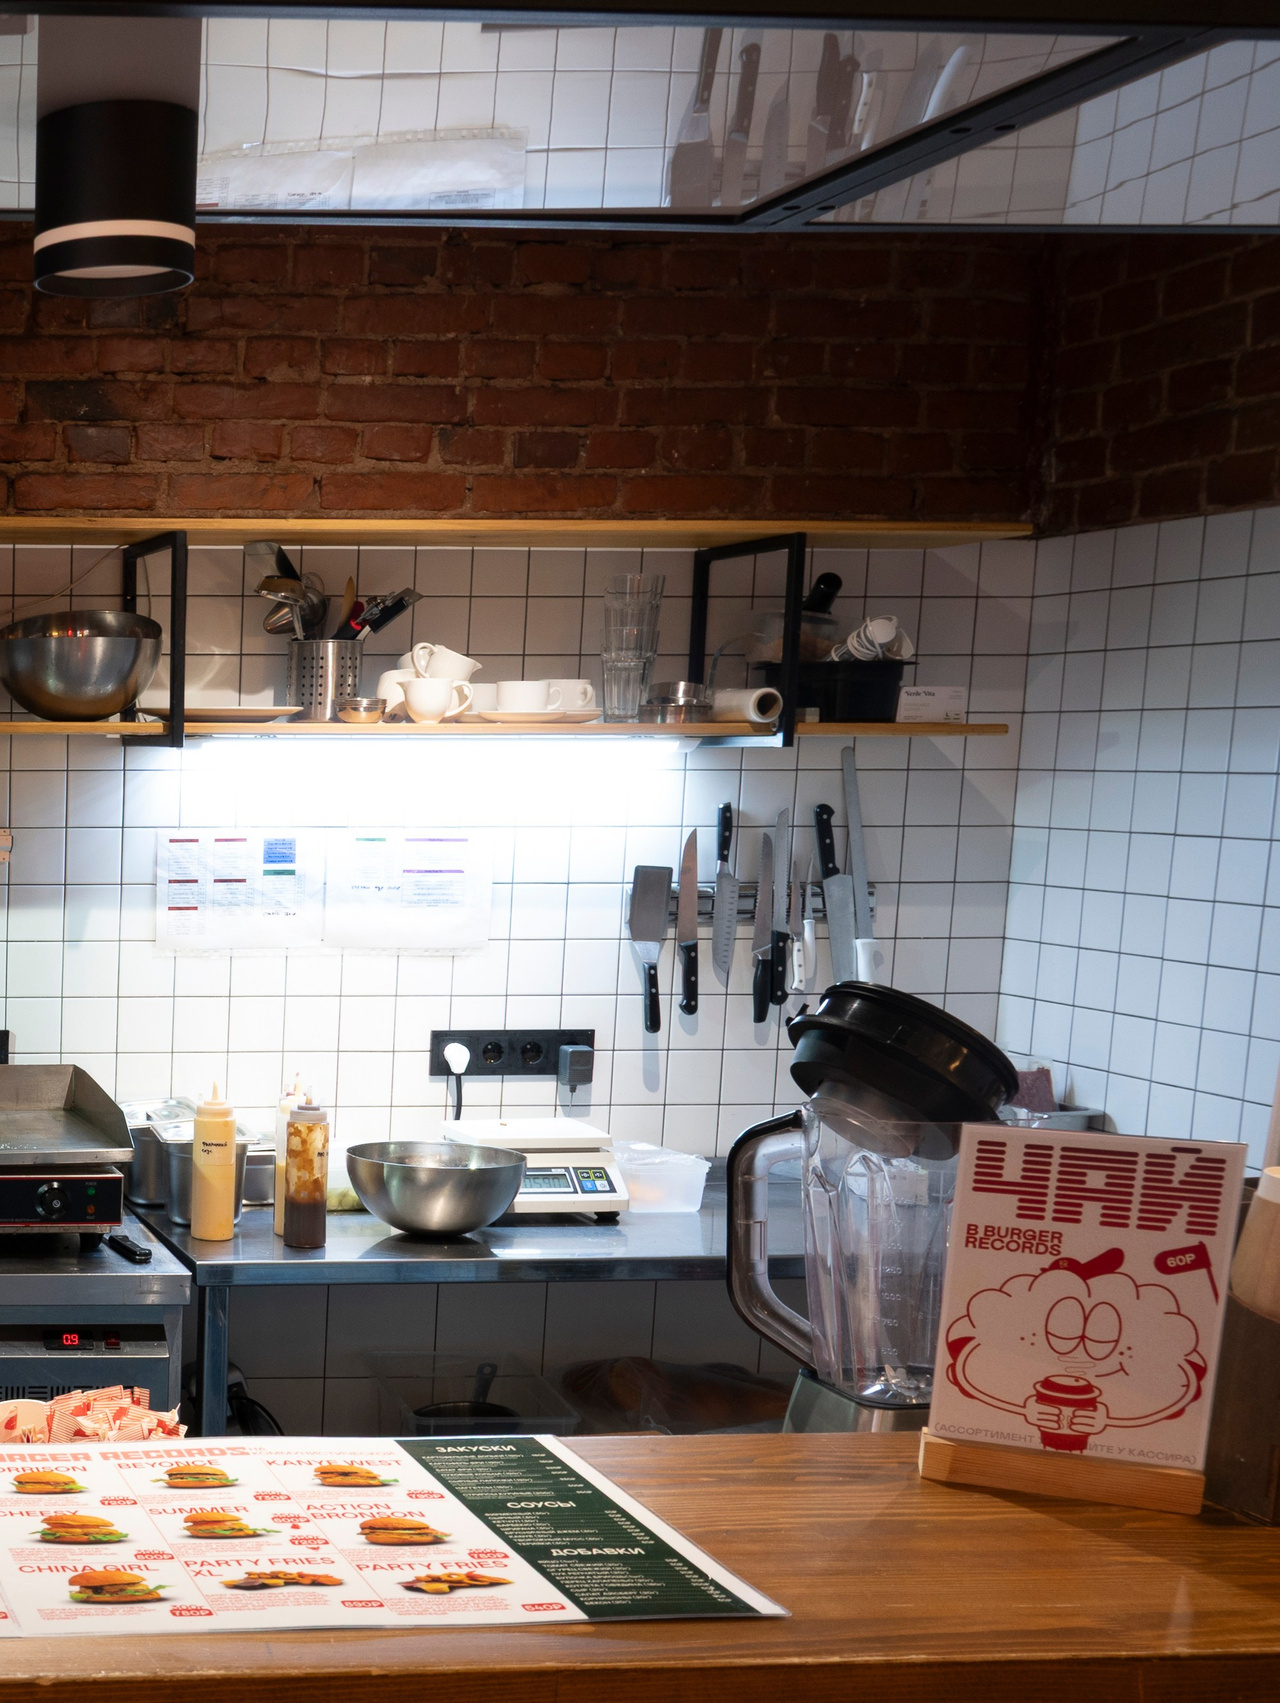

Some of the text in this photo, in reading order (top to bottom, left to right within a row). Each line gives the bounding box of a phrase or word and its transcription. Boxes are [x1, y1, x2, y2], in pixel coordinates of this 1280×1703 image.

[984, 1225, 1063, 1244] BURGER
[964, 1236, 1063, 1257] RECORDS
[98, 1446, 251, 1461] RECORDS
[435, 1445, 517, 1453] ЗАКУСКИ
[117, 1459, 221, 1469] BEYONCE
[266, 1459, 403, 1467] KANYE WEST
[149, 1505, 250, 1515] SUMMER
[306, 1503, 392, 1511] ACTION
[310, 1511, 426, 1520] BRONSON
[551, 1548, 645, 1556] ДОБАВКИ
[184, 1557, 336, 1568] PARTY FRIES
[355, 1560, 509, 1572] PARTY FRIES
[19, 1563, 160, 1574] CHINA GIRL
[190, 1569, 224, 1577] XL
